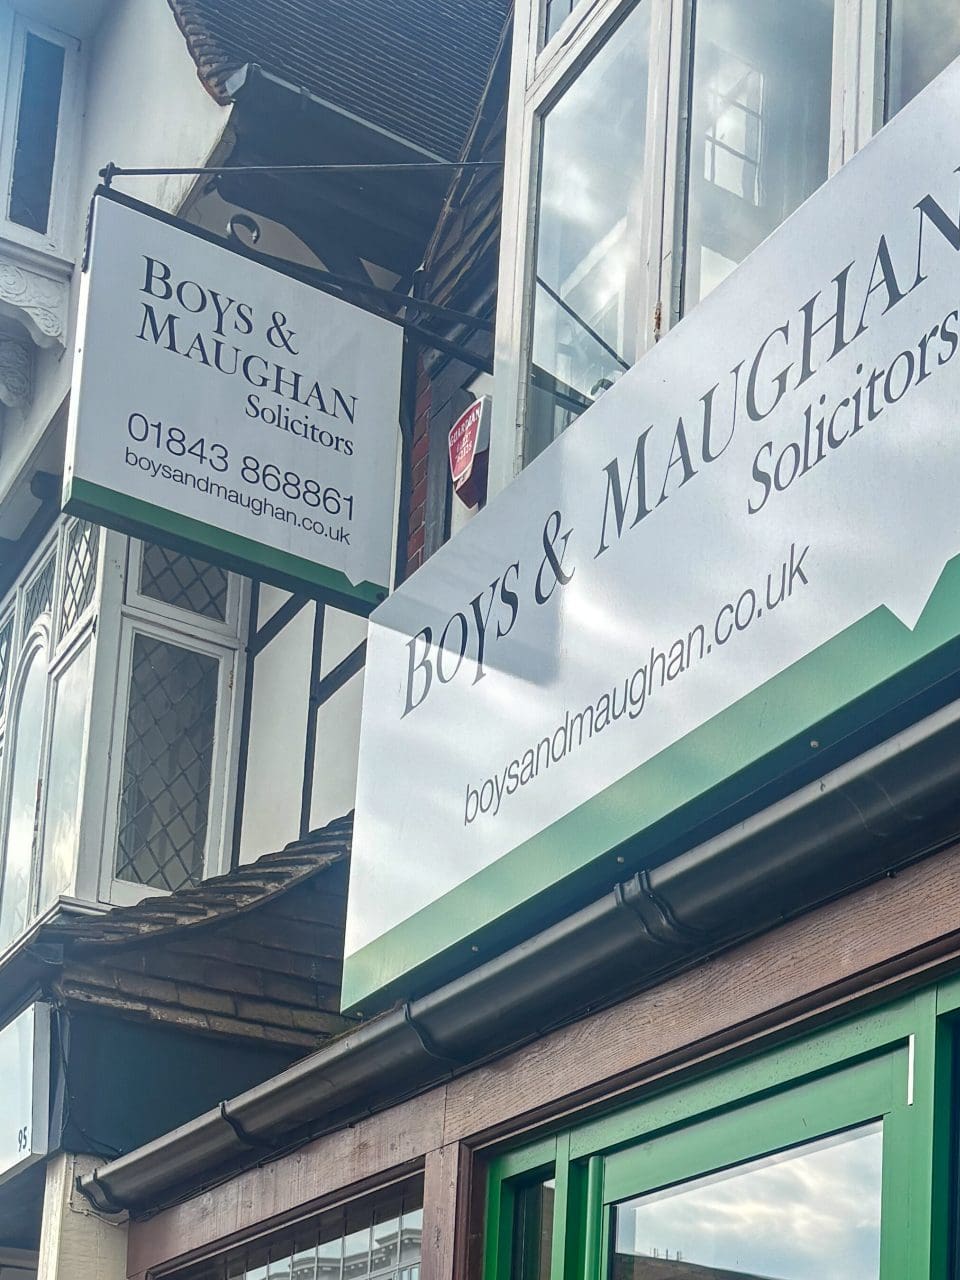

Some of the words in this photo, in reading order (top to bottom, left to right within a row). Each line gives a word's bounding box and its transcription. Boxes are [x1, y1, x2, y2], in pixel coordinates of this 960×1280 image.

[140, 255, 254, 338] BOYS
[266, 310, 300, 355] &
[135, 304, 359, 425] MAUGHAN
[748, 309, 960, 515] Solicitors
[127, 412, 229, 472] 01843
[240, 455, 355, 521] 868861
[245, 394, 355, 457] Solicitors
[125, 446, 351, 545] boysandmaughan.co.uk
[400, 564, 520, 720] BOYS
[534, 510, 577, 605] &
[463, 541, 811, 827] boysandmaughan.co.uk
